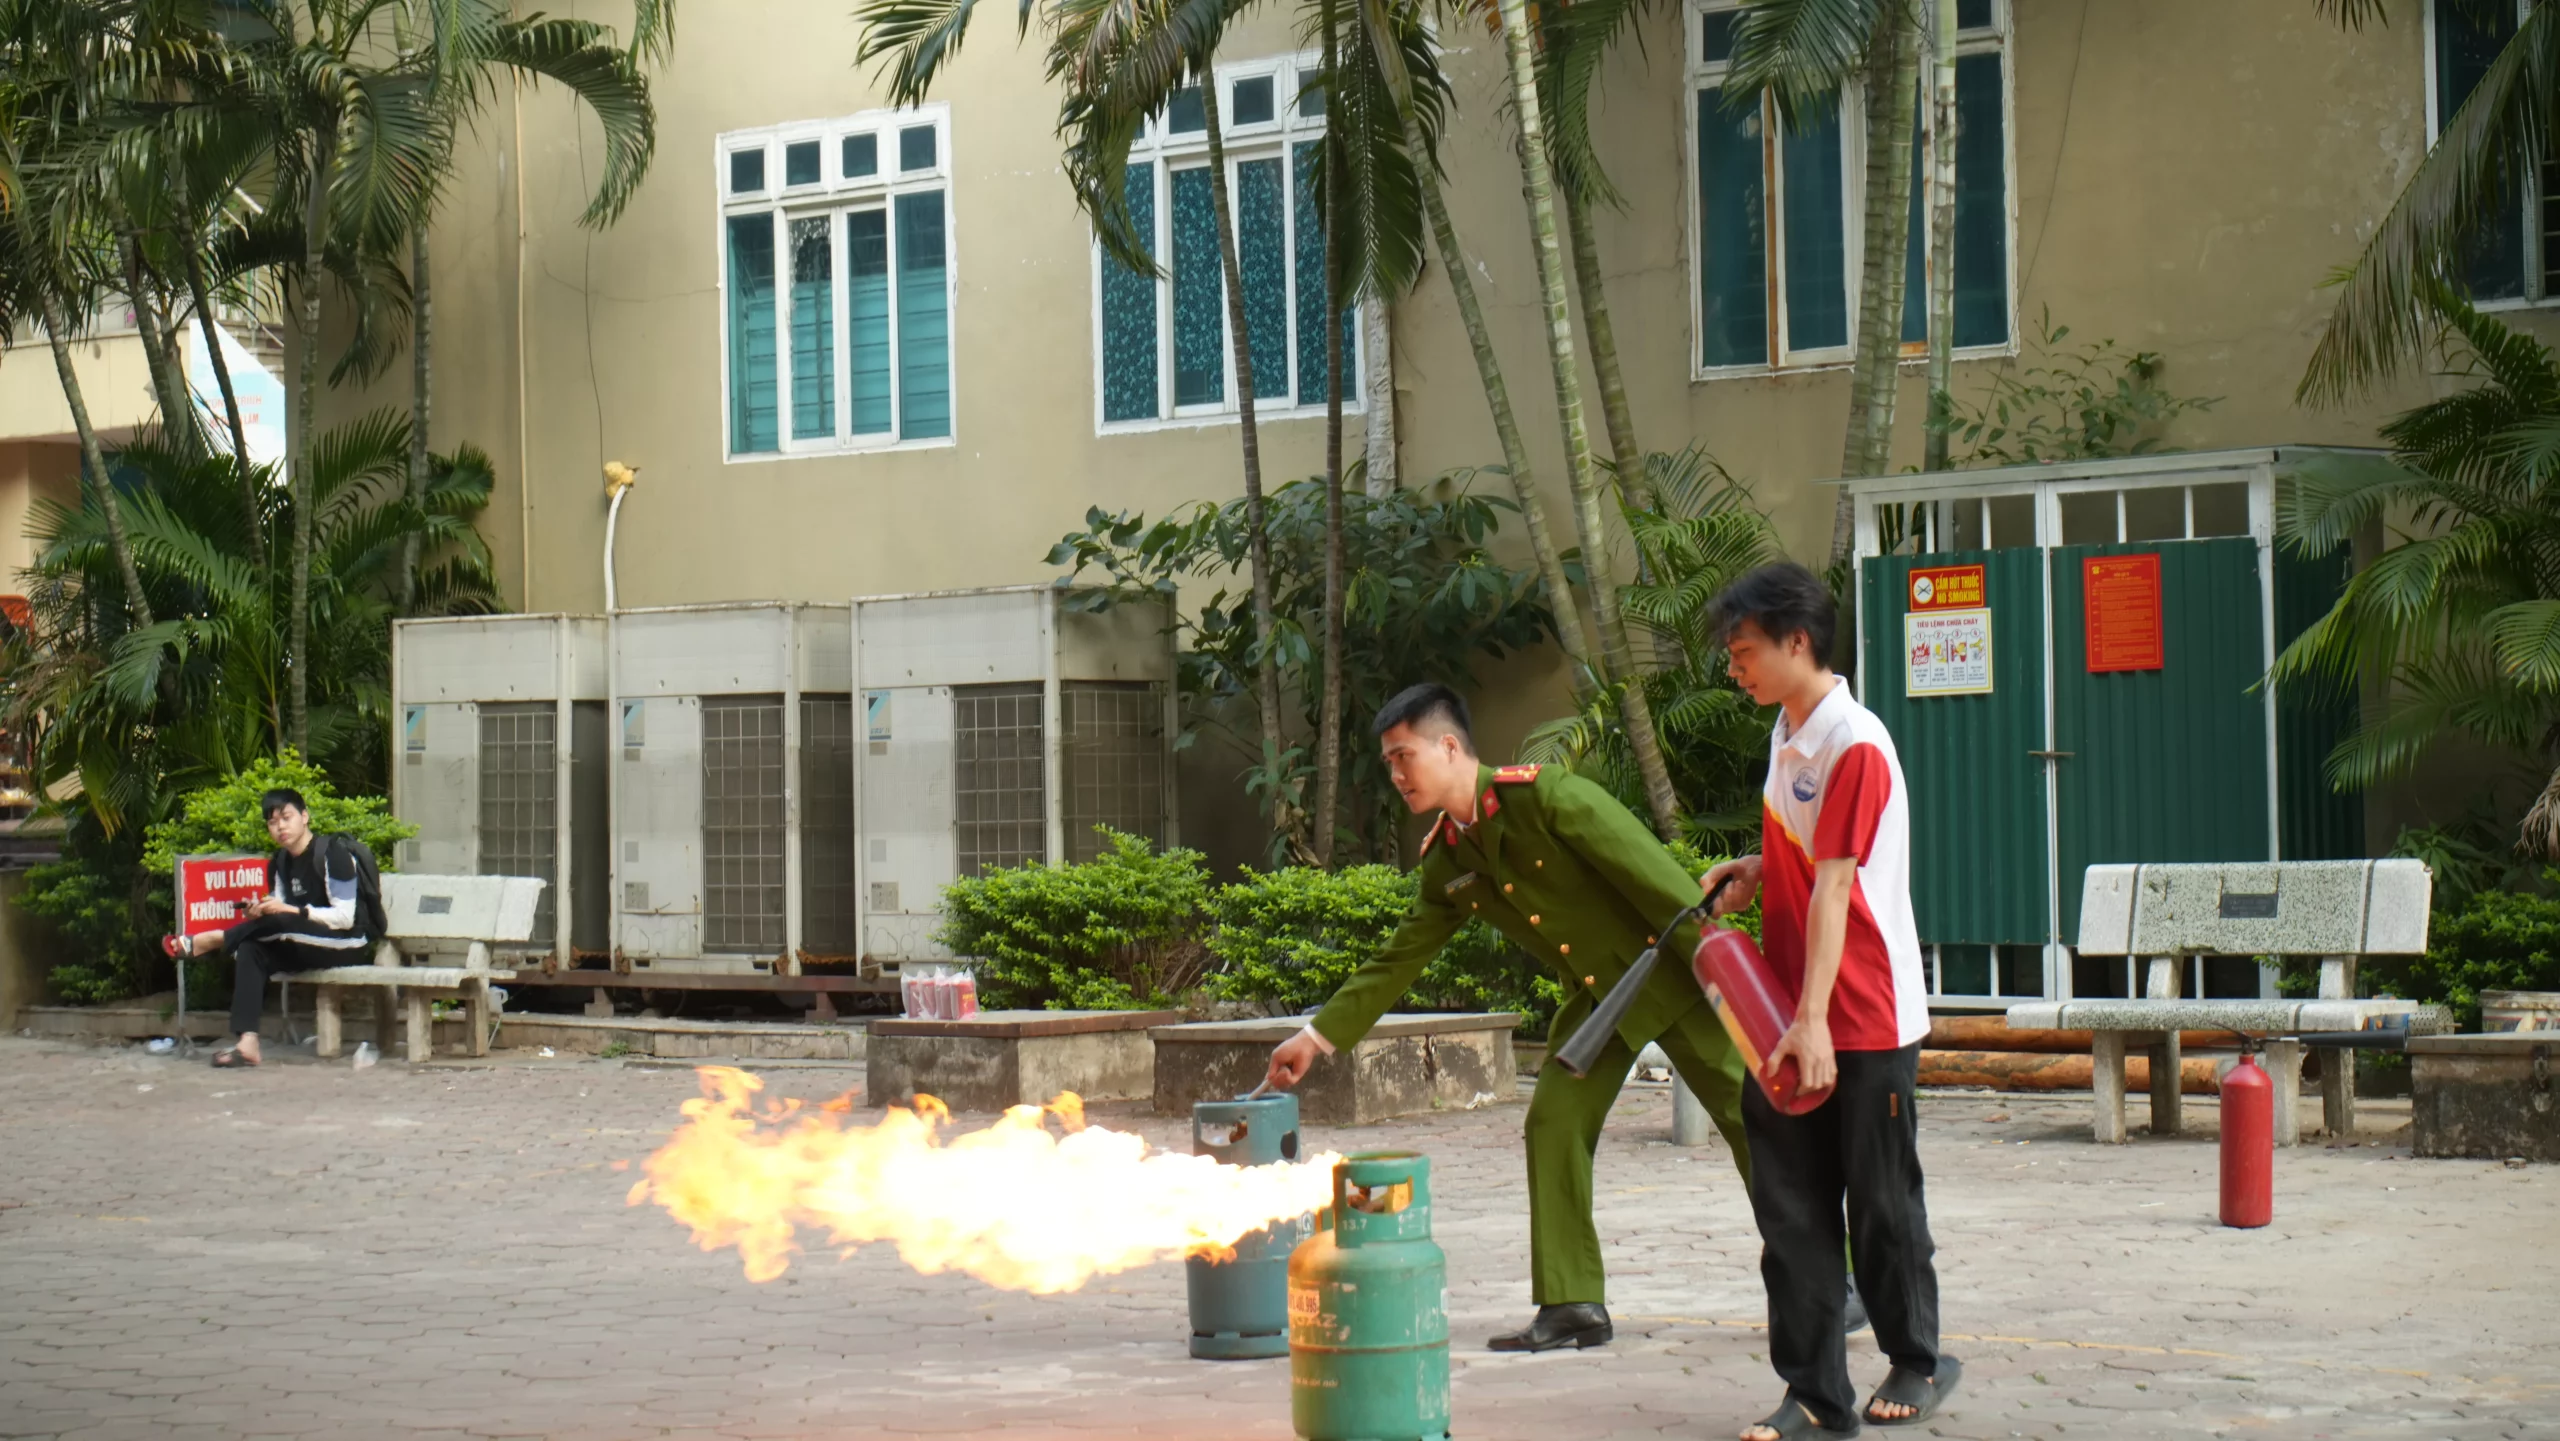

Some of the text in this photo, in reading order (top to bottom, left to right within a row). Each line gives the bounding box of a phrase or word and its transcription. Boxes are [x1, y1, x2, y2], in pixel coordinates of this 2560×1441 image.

[1935, 572, 1949, 590] CẤM
[1961, 570, 1980, 589] THUỐC
[1936, 589, 1980, 604] NO SMOKING
[204, 870, 227, 891] VUI
[190, 897, 235, 921] KHÔNG
[1342, 1218, 1368, 1231] 13.7
